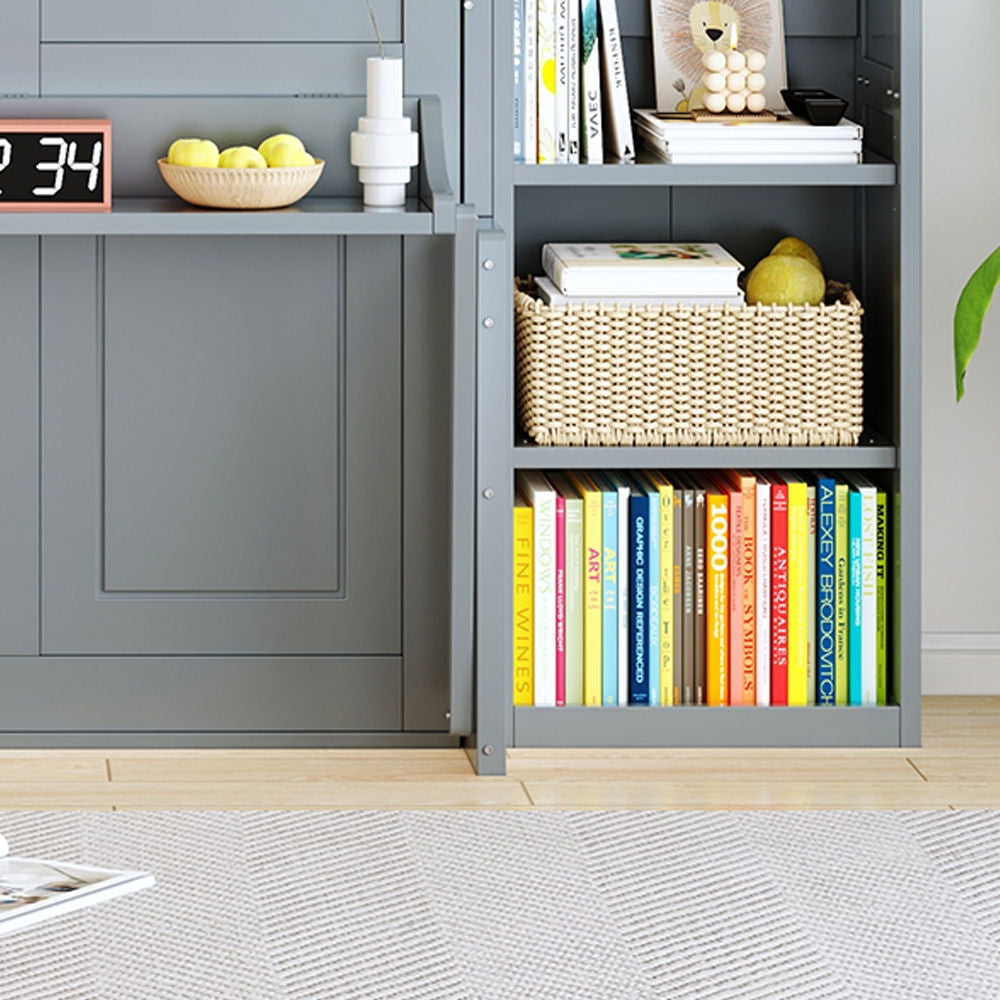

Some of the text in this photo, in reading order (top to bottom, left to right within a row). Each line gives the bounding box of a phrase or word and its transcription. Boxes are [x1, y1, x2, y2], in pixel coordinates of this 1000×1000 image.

[608, 27, 623, 89] KINFOLK
[32, 137, 102, 196] 34
[539, 500, 552, 594] WINDOWS
[588, 547, 601, 584] ART
[604, 547, 617, 584] ART
[636, 516, 645, 566] GRAPHIC
[711, 503, 728, 572] 1000
[743, 537, 754, 585] BOOK
[636, 568, 645, 609] DESIGN
[820, 485, 834, 706] ALEXEY BRODOVITCH
[877, 564, 884, 579] IT
[516, 537, 530, 693] FINE WINES
[777, 546, 787, 666] ANTIQUAIRES
[838, 609, 845, 619] in
[636, 611, 645, 684] REFERENCED
[743, 603, 754, 691] SYMBOLS
